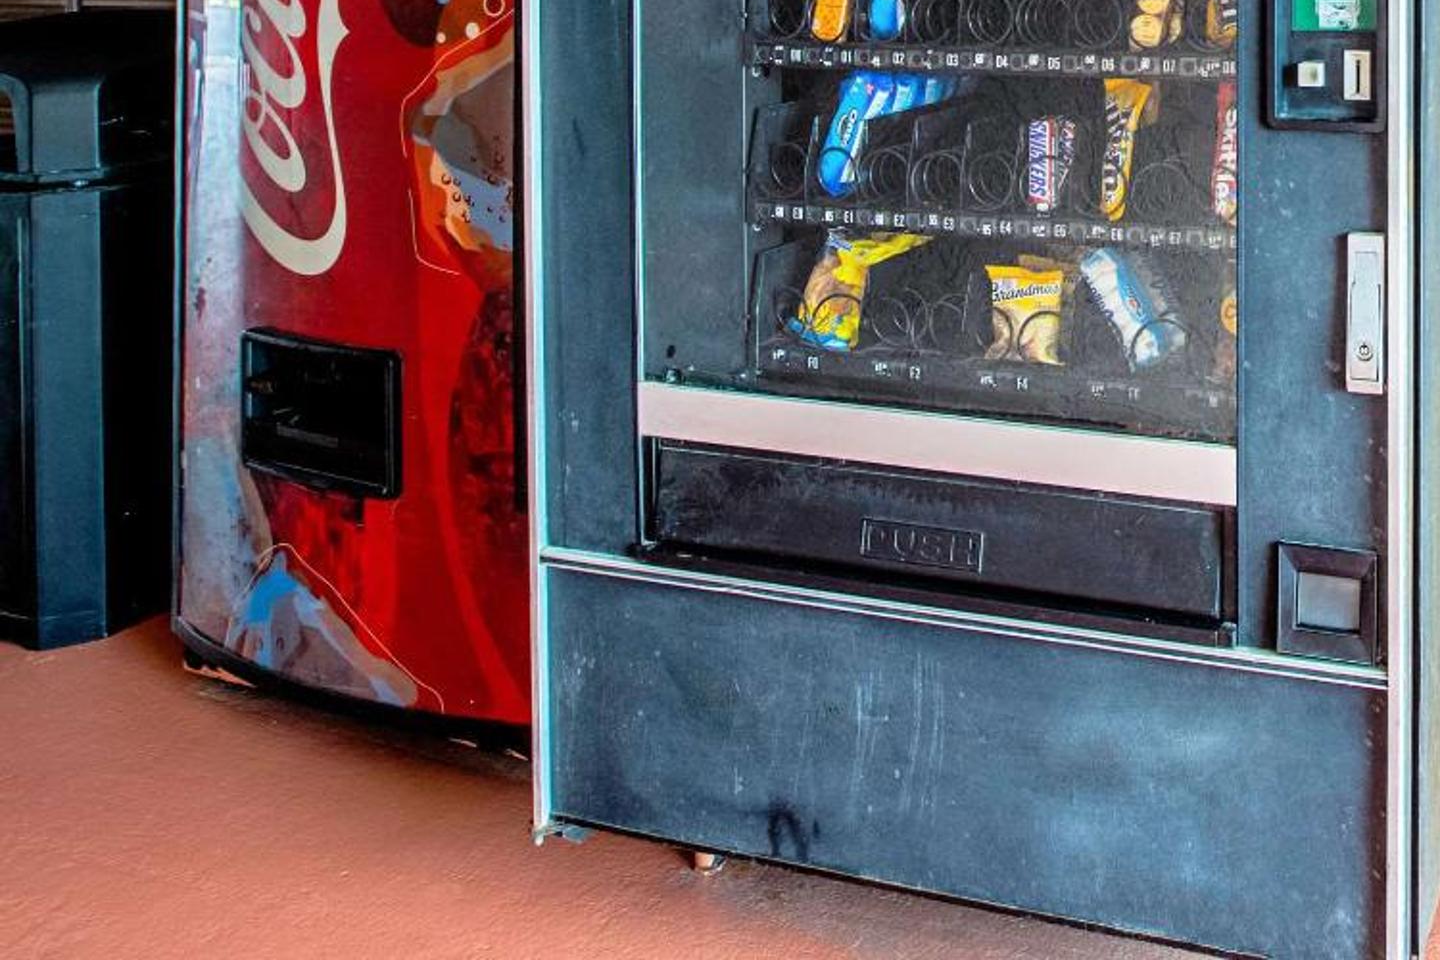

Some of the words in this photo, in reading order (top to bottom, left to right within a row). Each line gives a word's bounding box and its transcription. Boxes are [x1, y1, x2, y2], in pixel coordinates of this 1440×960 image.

[844, 210, 853, 223] E1
[894, 214, 905, 227] E2
[1000, 221, 1011, 234] E4
